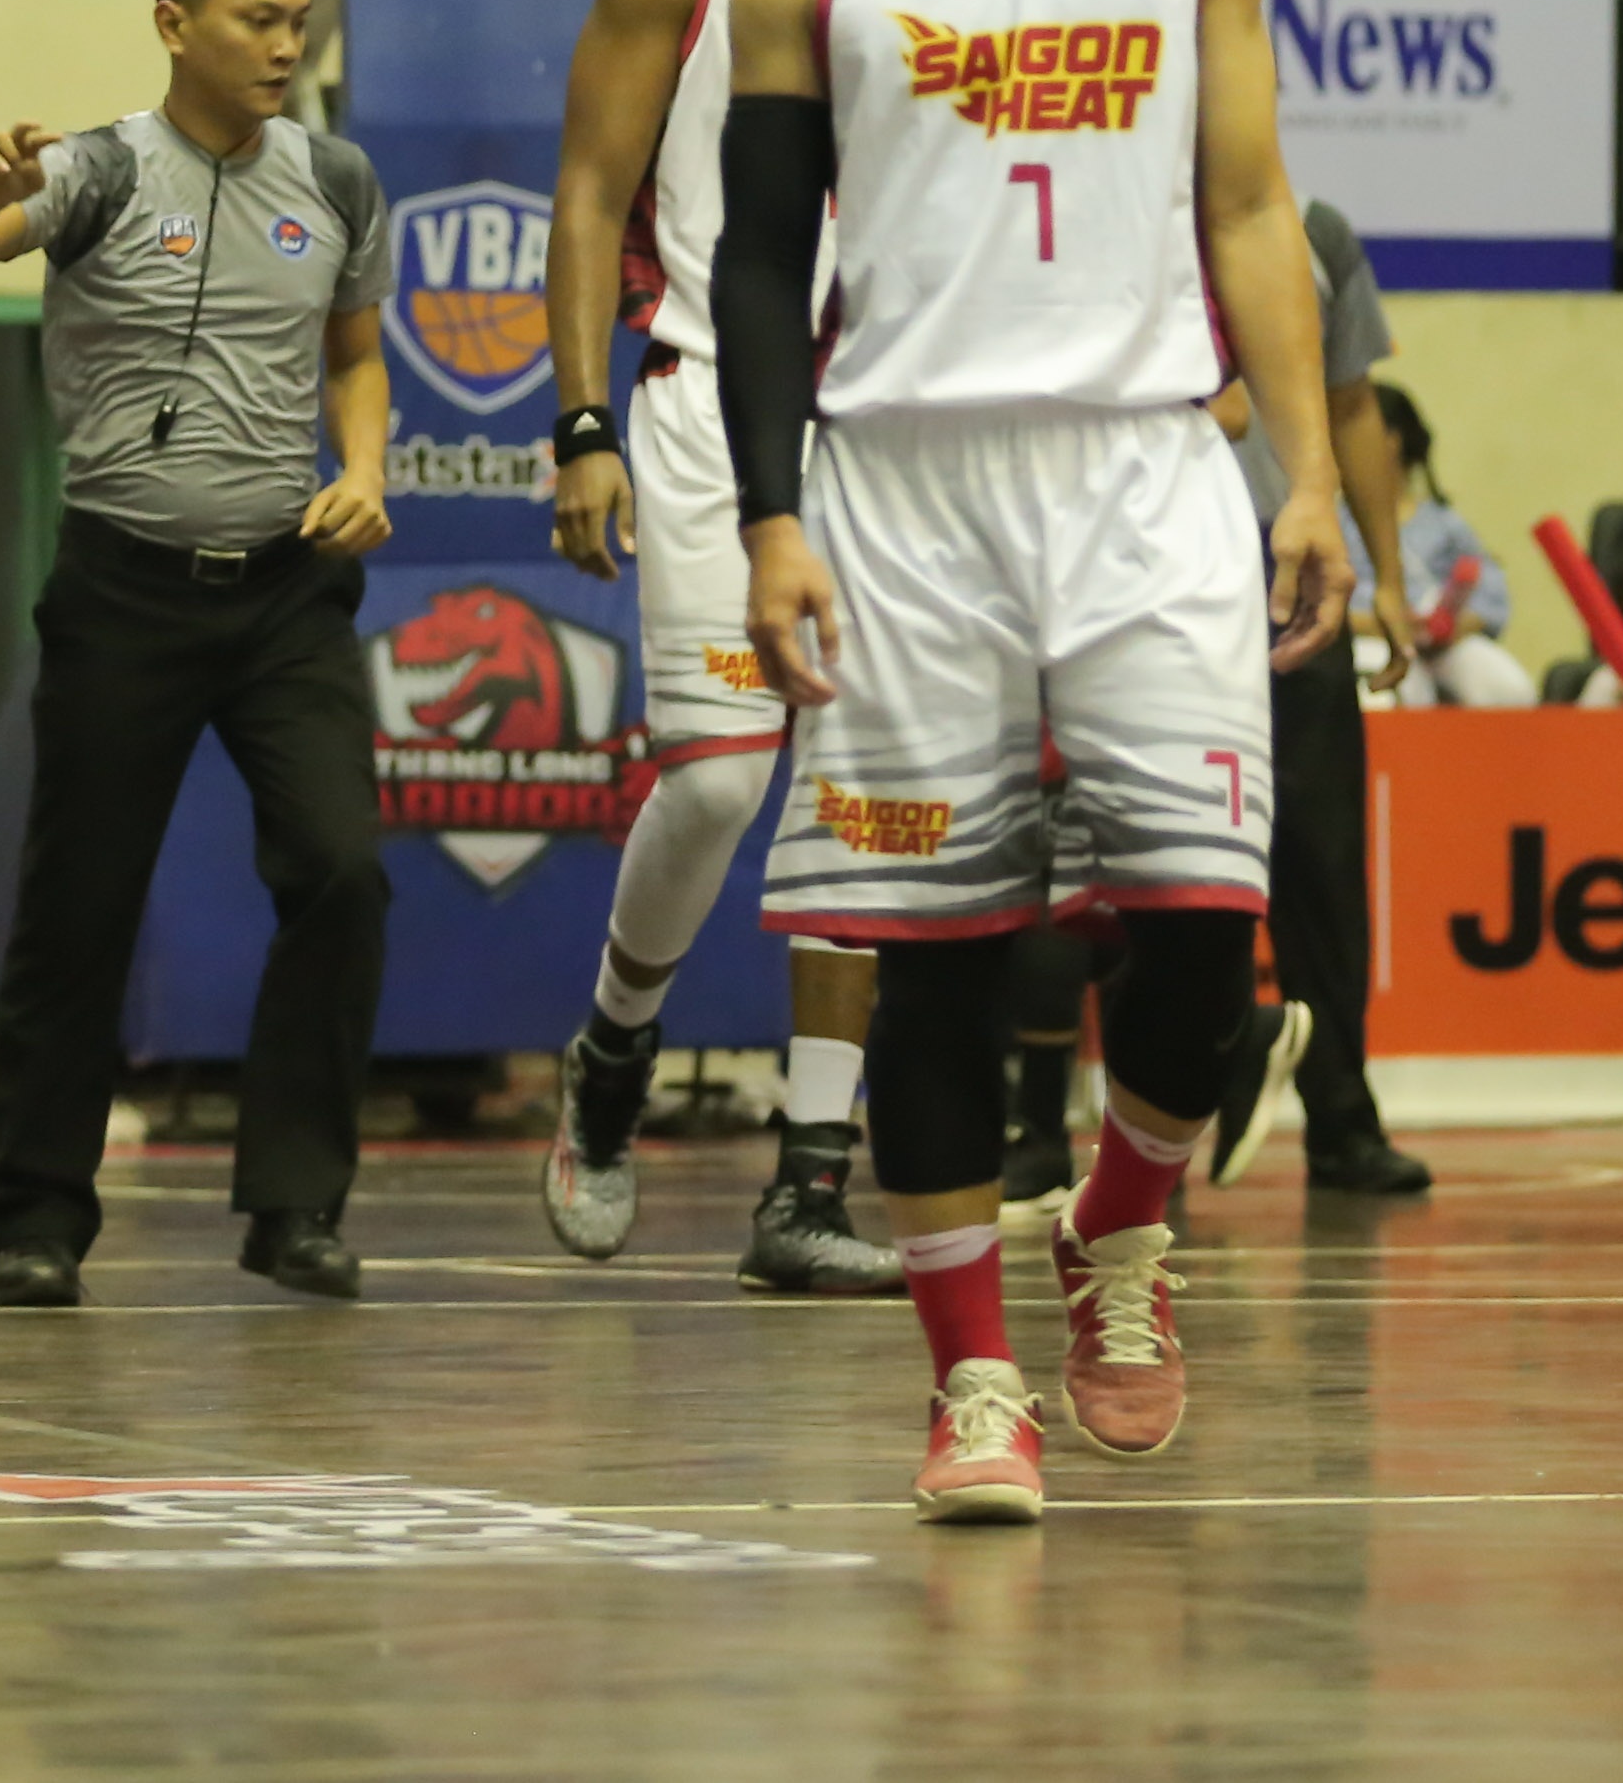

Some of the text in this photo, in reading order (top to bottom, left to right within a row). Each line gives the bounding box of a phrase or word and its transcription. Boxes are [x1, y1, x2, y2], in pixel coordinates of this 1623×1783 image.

[909, 22, 1161, 97] SAIGON
[970, 77, 1155, 139] HEAT
[415, 203, 550, 290] VBA
[1008, 162, 1054, 262] 7
[815, 796, 952, 827] SAIGON
[1204, 750, 1242, 826] 7
[840, 825, 946, 855] HEAT
